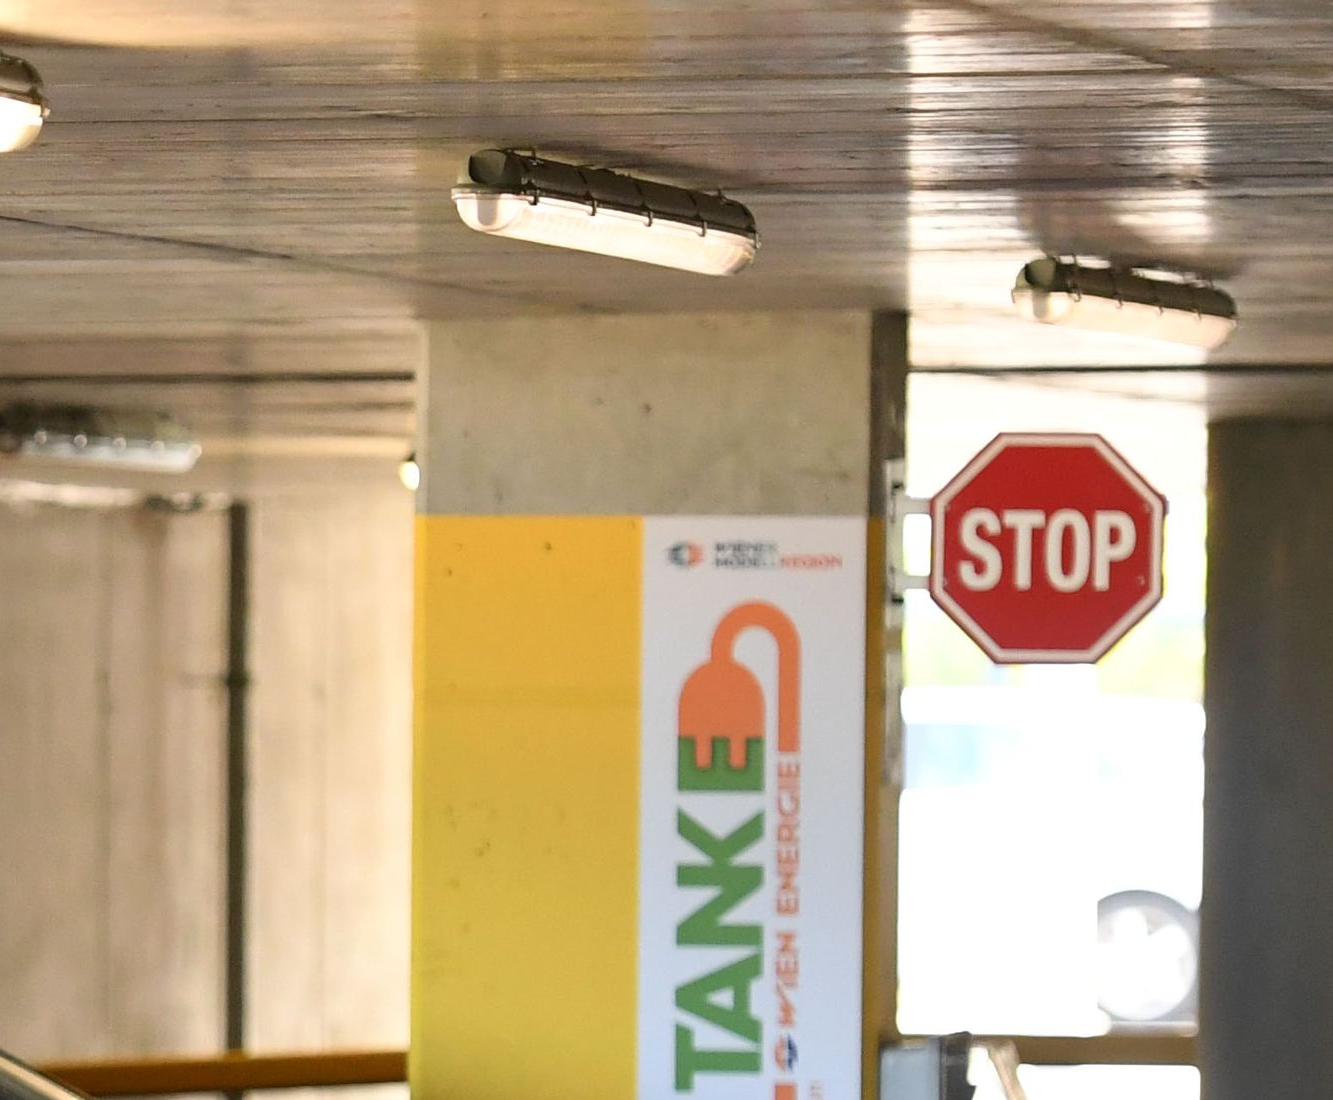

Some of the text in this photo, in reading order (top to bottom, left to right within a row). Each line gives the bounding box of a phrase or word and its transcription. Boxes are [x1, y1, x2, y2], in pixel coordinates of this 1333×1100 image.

[958, 507, 1137, 593] STOP
[674, 736, 766, 1092] TANKE
[774, 762, 801, 1029] WIEN ENERGIE
